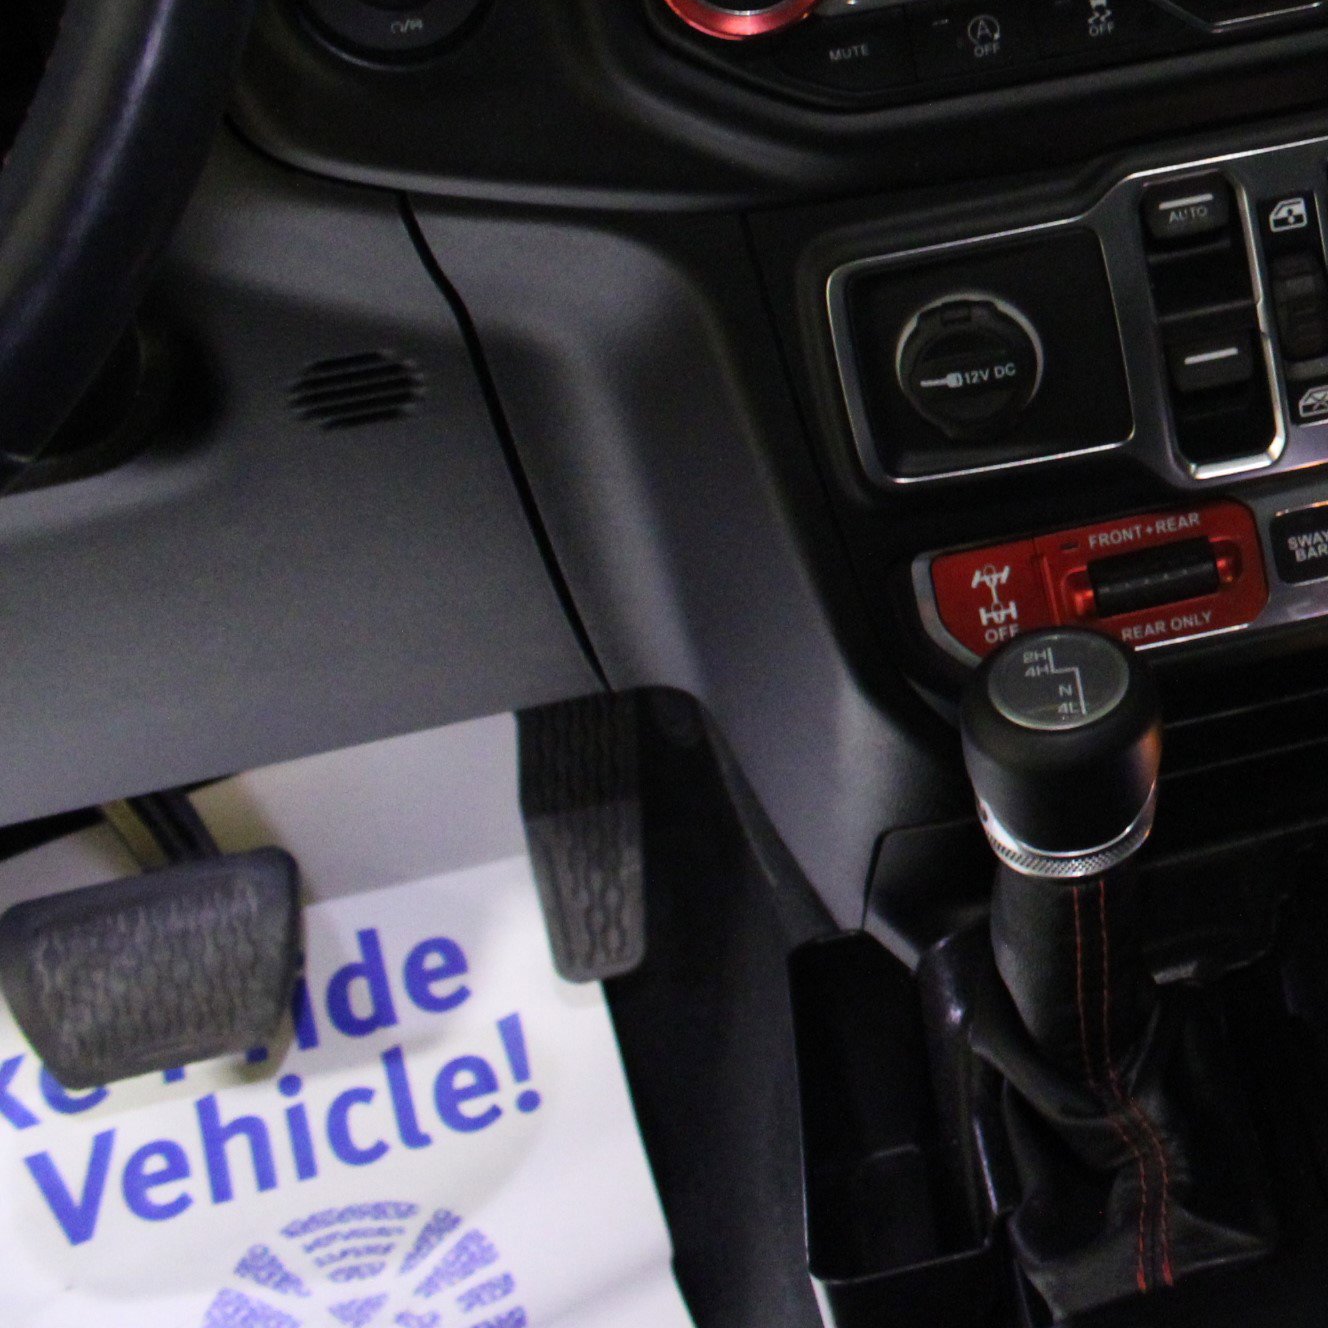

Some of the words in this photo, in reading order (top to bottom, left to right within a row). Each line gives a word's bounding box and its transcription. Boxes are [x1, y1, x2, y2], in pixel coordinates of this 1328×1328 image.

[1088, 21, 1115, 38] OFF
[829, 43, 869, 61] MUTE
[974, 43, 1000, 59] OFF
[1168, 206, 1209, 225] AUTO
[963, 369, 991, 385] 12V
[993, 362, 1017, 380] DC
[984, 624, 1020, 644] OFF
[1120, 616, 1168, 642] REAR
[1170, 610, 1214, 635] ONLY
[1022, 649, 1048, 665] 2H
[1024, 663, 1050, 678] 4H
[1058, 684, 1073, 697] N
[1056, 701, 1079, 714] 4L
[24, 1011, 541, 1247] Vehicle!
